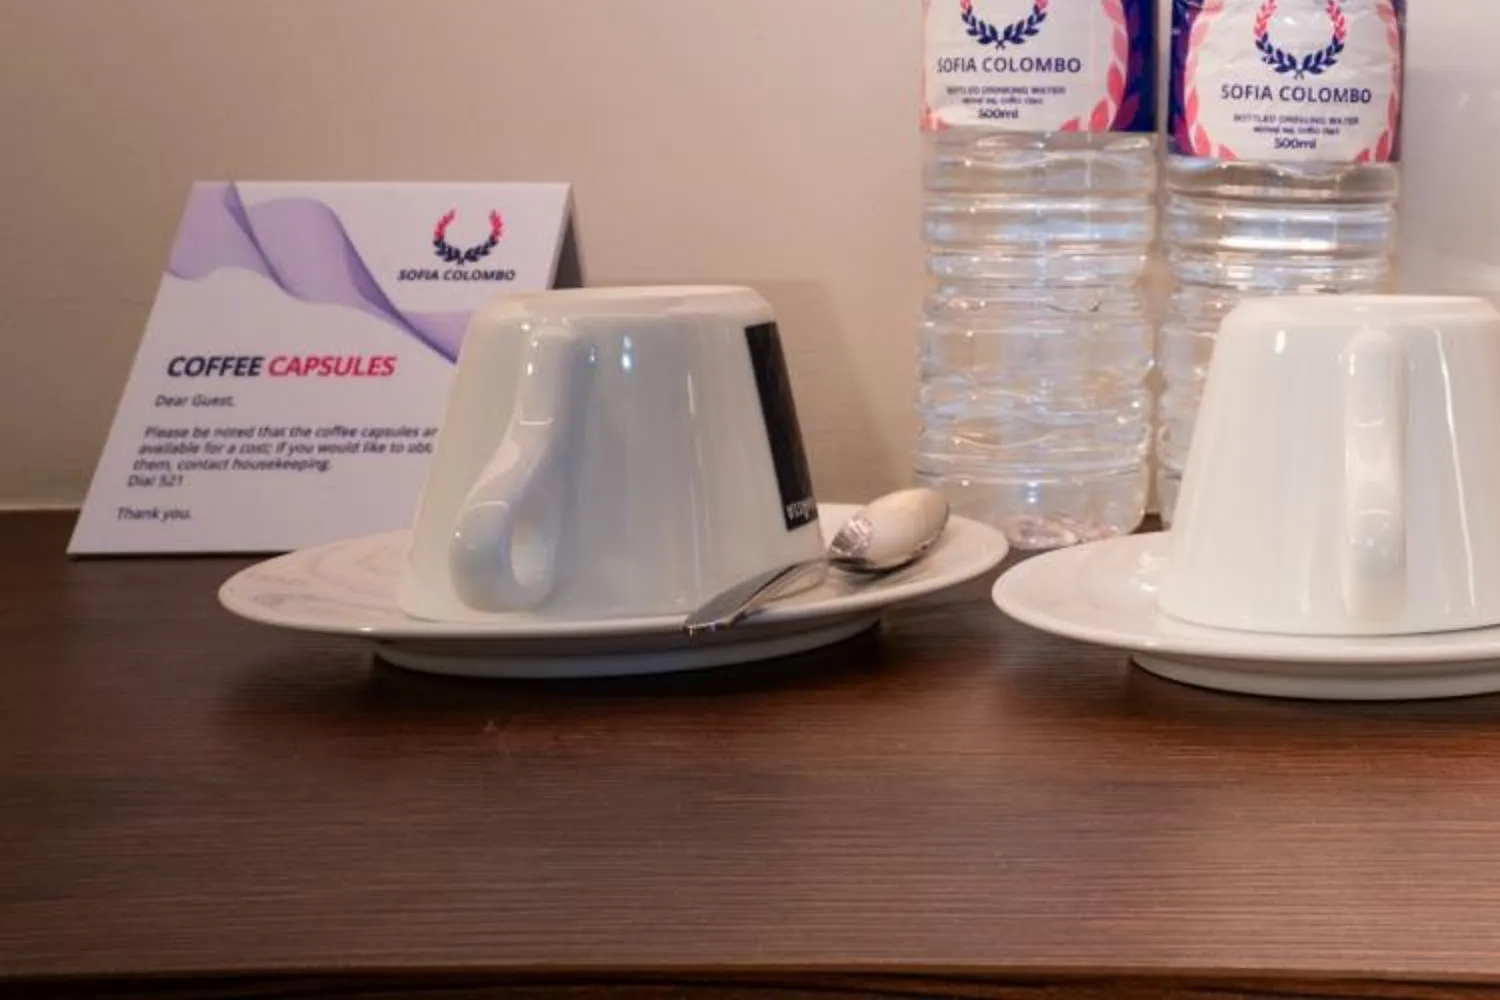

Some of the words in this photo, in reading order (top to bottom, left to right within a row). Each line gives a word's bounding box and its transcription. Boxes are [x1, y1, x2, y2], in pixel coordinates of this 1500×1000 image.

[937, 57, 977, 73] SOFIA
[982, 57, 1081, 73] COLOMBO
[1221, 84, 1273, 100] SOFIA
[1279, 86, 1372, 104] COLOMBO
[1274, 138, 1317, 149] 500ml
[398, 269, 439, 281] SOFIA
[443, 269, 516, 281] COLOMBO
[167, 356, 264, 377] COFFEE
[268, 356, 397, 377] CAPSULES
[154, 395, 188, 407] Dear
[144, 427, 190, 438] Please
[193, 427, 210, 438] be
[213, 427, 254, 438] noted
[257, 427, 285, 438] that
[289, 427, 312, 438] the
[315, 425, 357, 438] coffee
[361, 426, 419, 440] capsules
[422, 428, 438, 437] ar
[138, 443, 199, 454] available
[203, 443, 225, 454] for
[227, 446, 236, 454] a
[275, 443, 287, 454] if
[288, 445, 314, 456] you
[318, 443, 360, 453] would
[363, 443, 387, 453] like
[390, 443, 405, 453] to
[408, 443, 433, 453] obt
[177, 459, 229, 471] contact
[127, 474, 155, 487] Dial
[159, 474, 184, 487] 521
[117, 507, 159, 520] Thank
